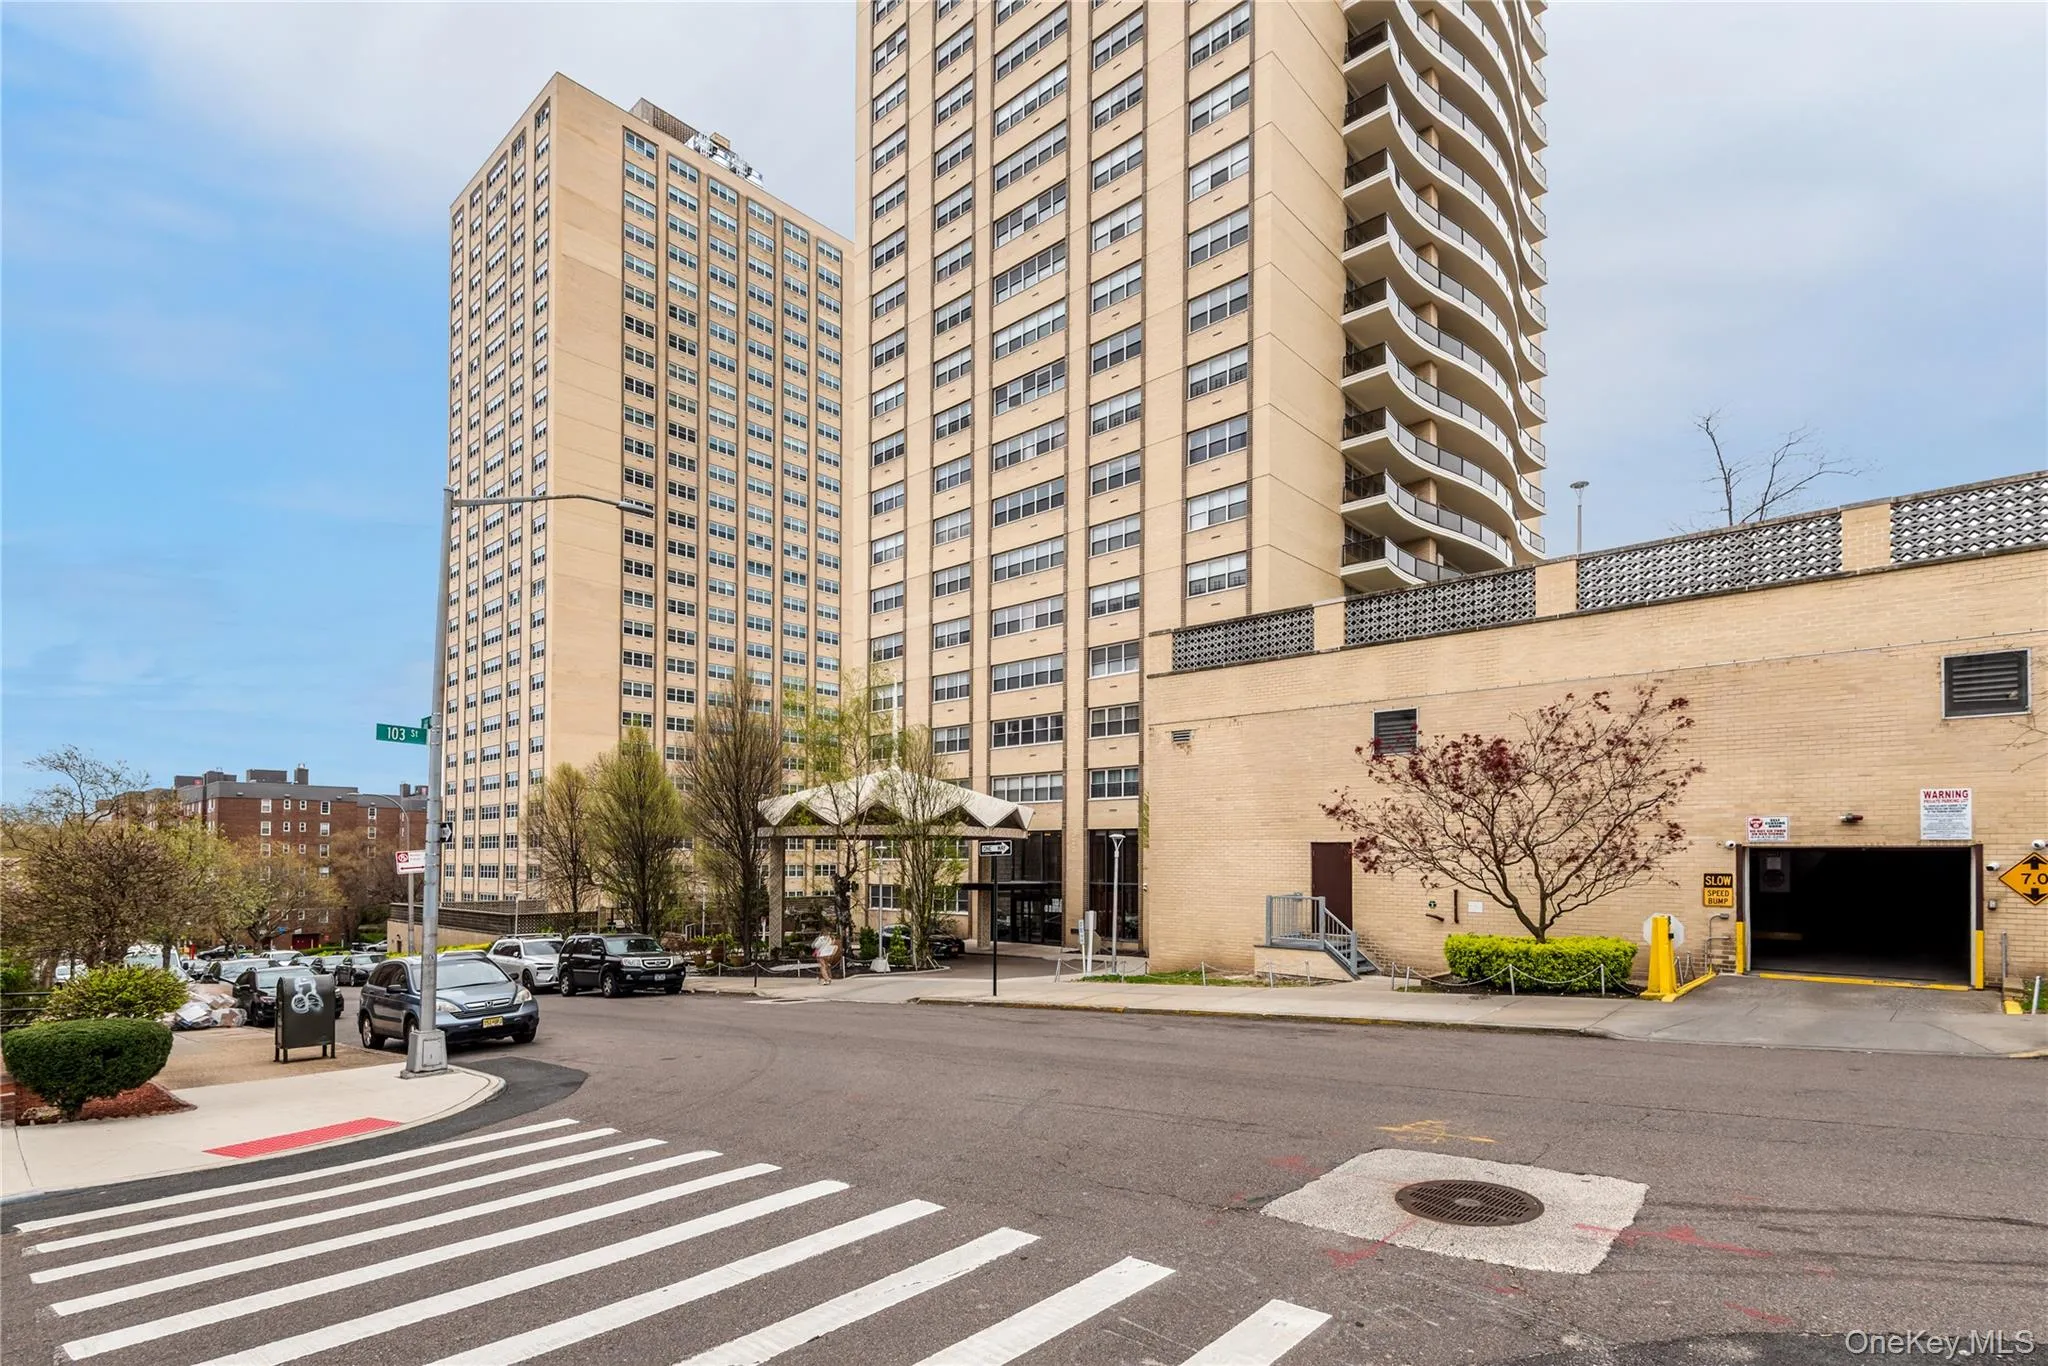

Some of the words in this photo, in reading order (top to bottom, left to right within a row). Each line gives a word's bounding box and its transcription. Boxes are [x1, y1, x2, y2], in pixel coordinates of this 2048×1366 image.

[387, 727, 406, 741] 103
[410, 729, 419, 738] St
[1923, 790, 1969, 799] WARNING
[1705, 876, 1732, 886] SLOW
